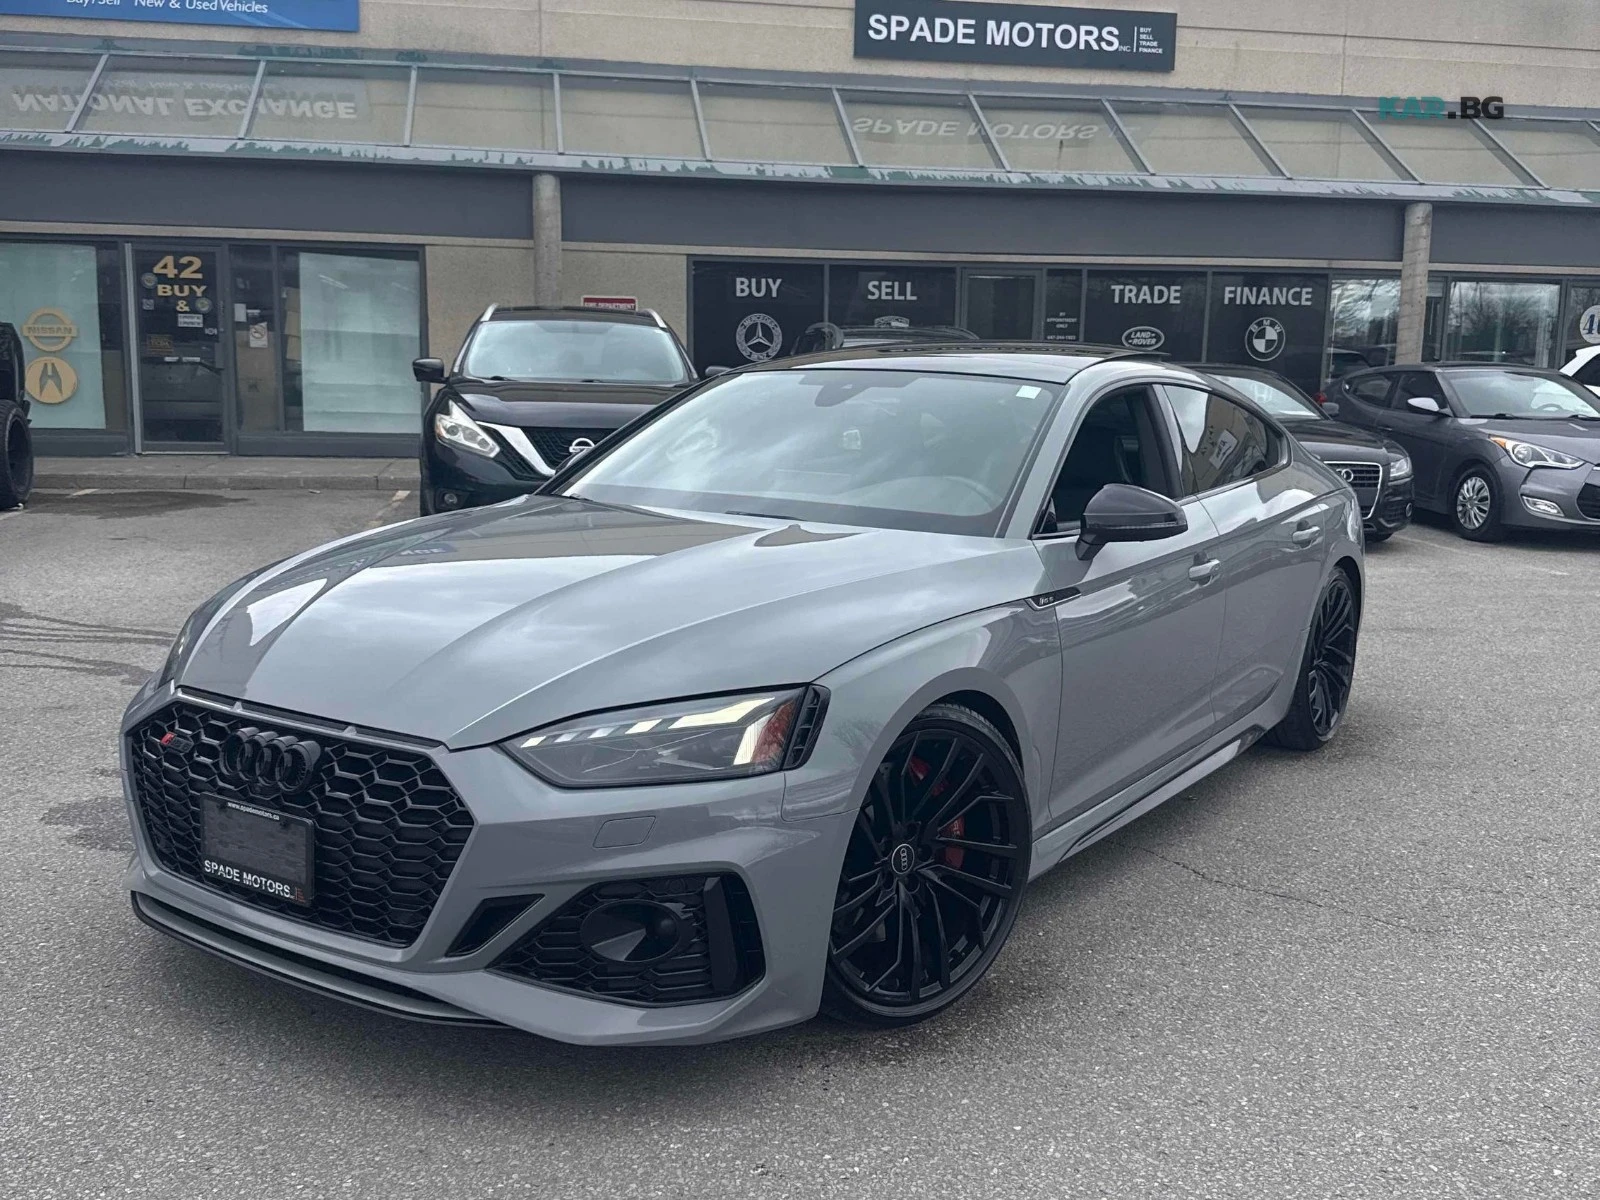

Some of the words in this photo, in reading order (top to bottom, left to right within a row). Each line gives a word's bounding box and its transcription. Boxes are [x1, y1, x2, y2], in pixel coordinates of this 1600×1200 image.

[169, 0, 181, 8] &
[186, 0, 217, 10] Used
[220, 0, 268, 13] Vehicles
[868, 14, 976, 44] SPADE
[986, 20, 1119, 52] MOTORS
[153, 255, 203, 279] 42
[157, 284, 207, 297] BUY
[735, 277, 782, 298] BUY
[867, 281, 917, 301] SELL
[1111, 285, 1181, 304] TRADE
[1224, 287, 1313, 306] FINANCE
[176, 300, 190, 312] &
[27, 326, 73, 335] NISSAN
[1250, 320, 1282, 333] BMW
[204, 860, 241, 881] SPADE
[243, 872, 291, 898] MOTORS
